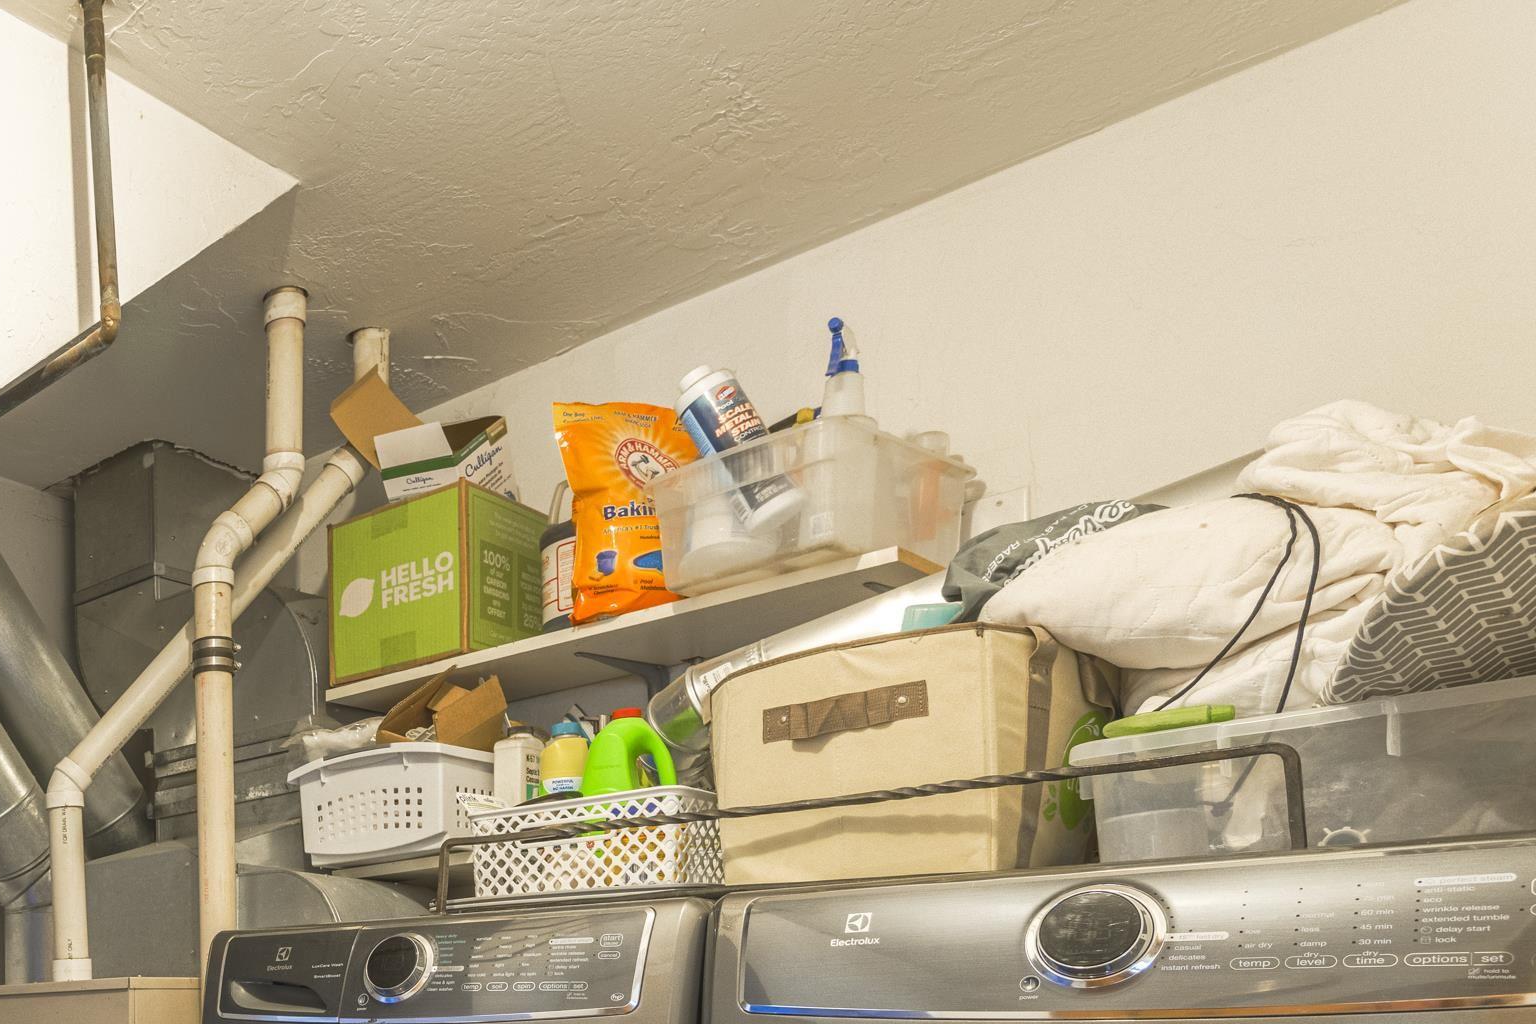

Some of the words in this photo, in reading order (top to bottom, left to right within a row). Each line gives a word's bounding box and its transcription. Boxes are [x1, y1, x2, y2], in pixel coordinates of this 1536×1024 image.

[715, 411, 752, 437] METAL
[731, 418, 760, 437] STAIN
[465, 445, 503, 478] Culligan
[405, 476, 434, 485] Culligan
[603, 500, 657, 521] Bakin
[483, 549, 511, 572] 100%
[381, 550, 454, 590] HELLO
[381, 571, 454, 609] FRESH
[1422, 915, 1470, 923] extended
[1472, 913, 1510, 921] tumble
[1435, 926, 1463, 934] delay
[830, 937, 880, 947] Electrolux
[1358, 938, 1371, 946] 30
[1238, 960, 1271, 968] temp
[1296, 957, 1325, 966] level
[1356, 956, 1385, 965] time
[1412, 955, 1468, 965] options
[1480, 954, 1505, 963] set
[266, 964, 293, 972] Electrolux
[1191, 963, 1221, 971] refresh
[463, 983, 479, 991] temp
